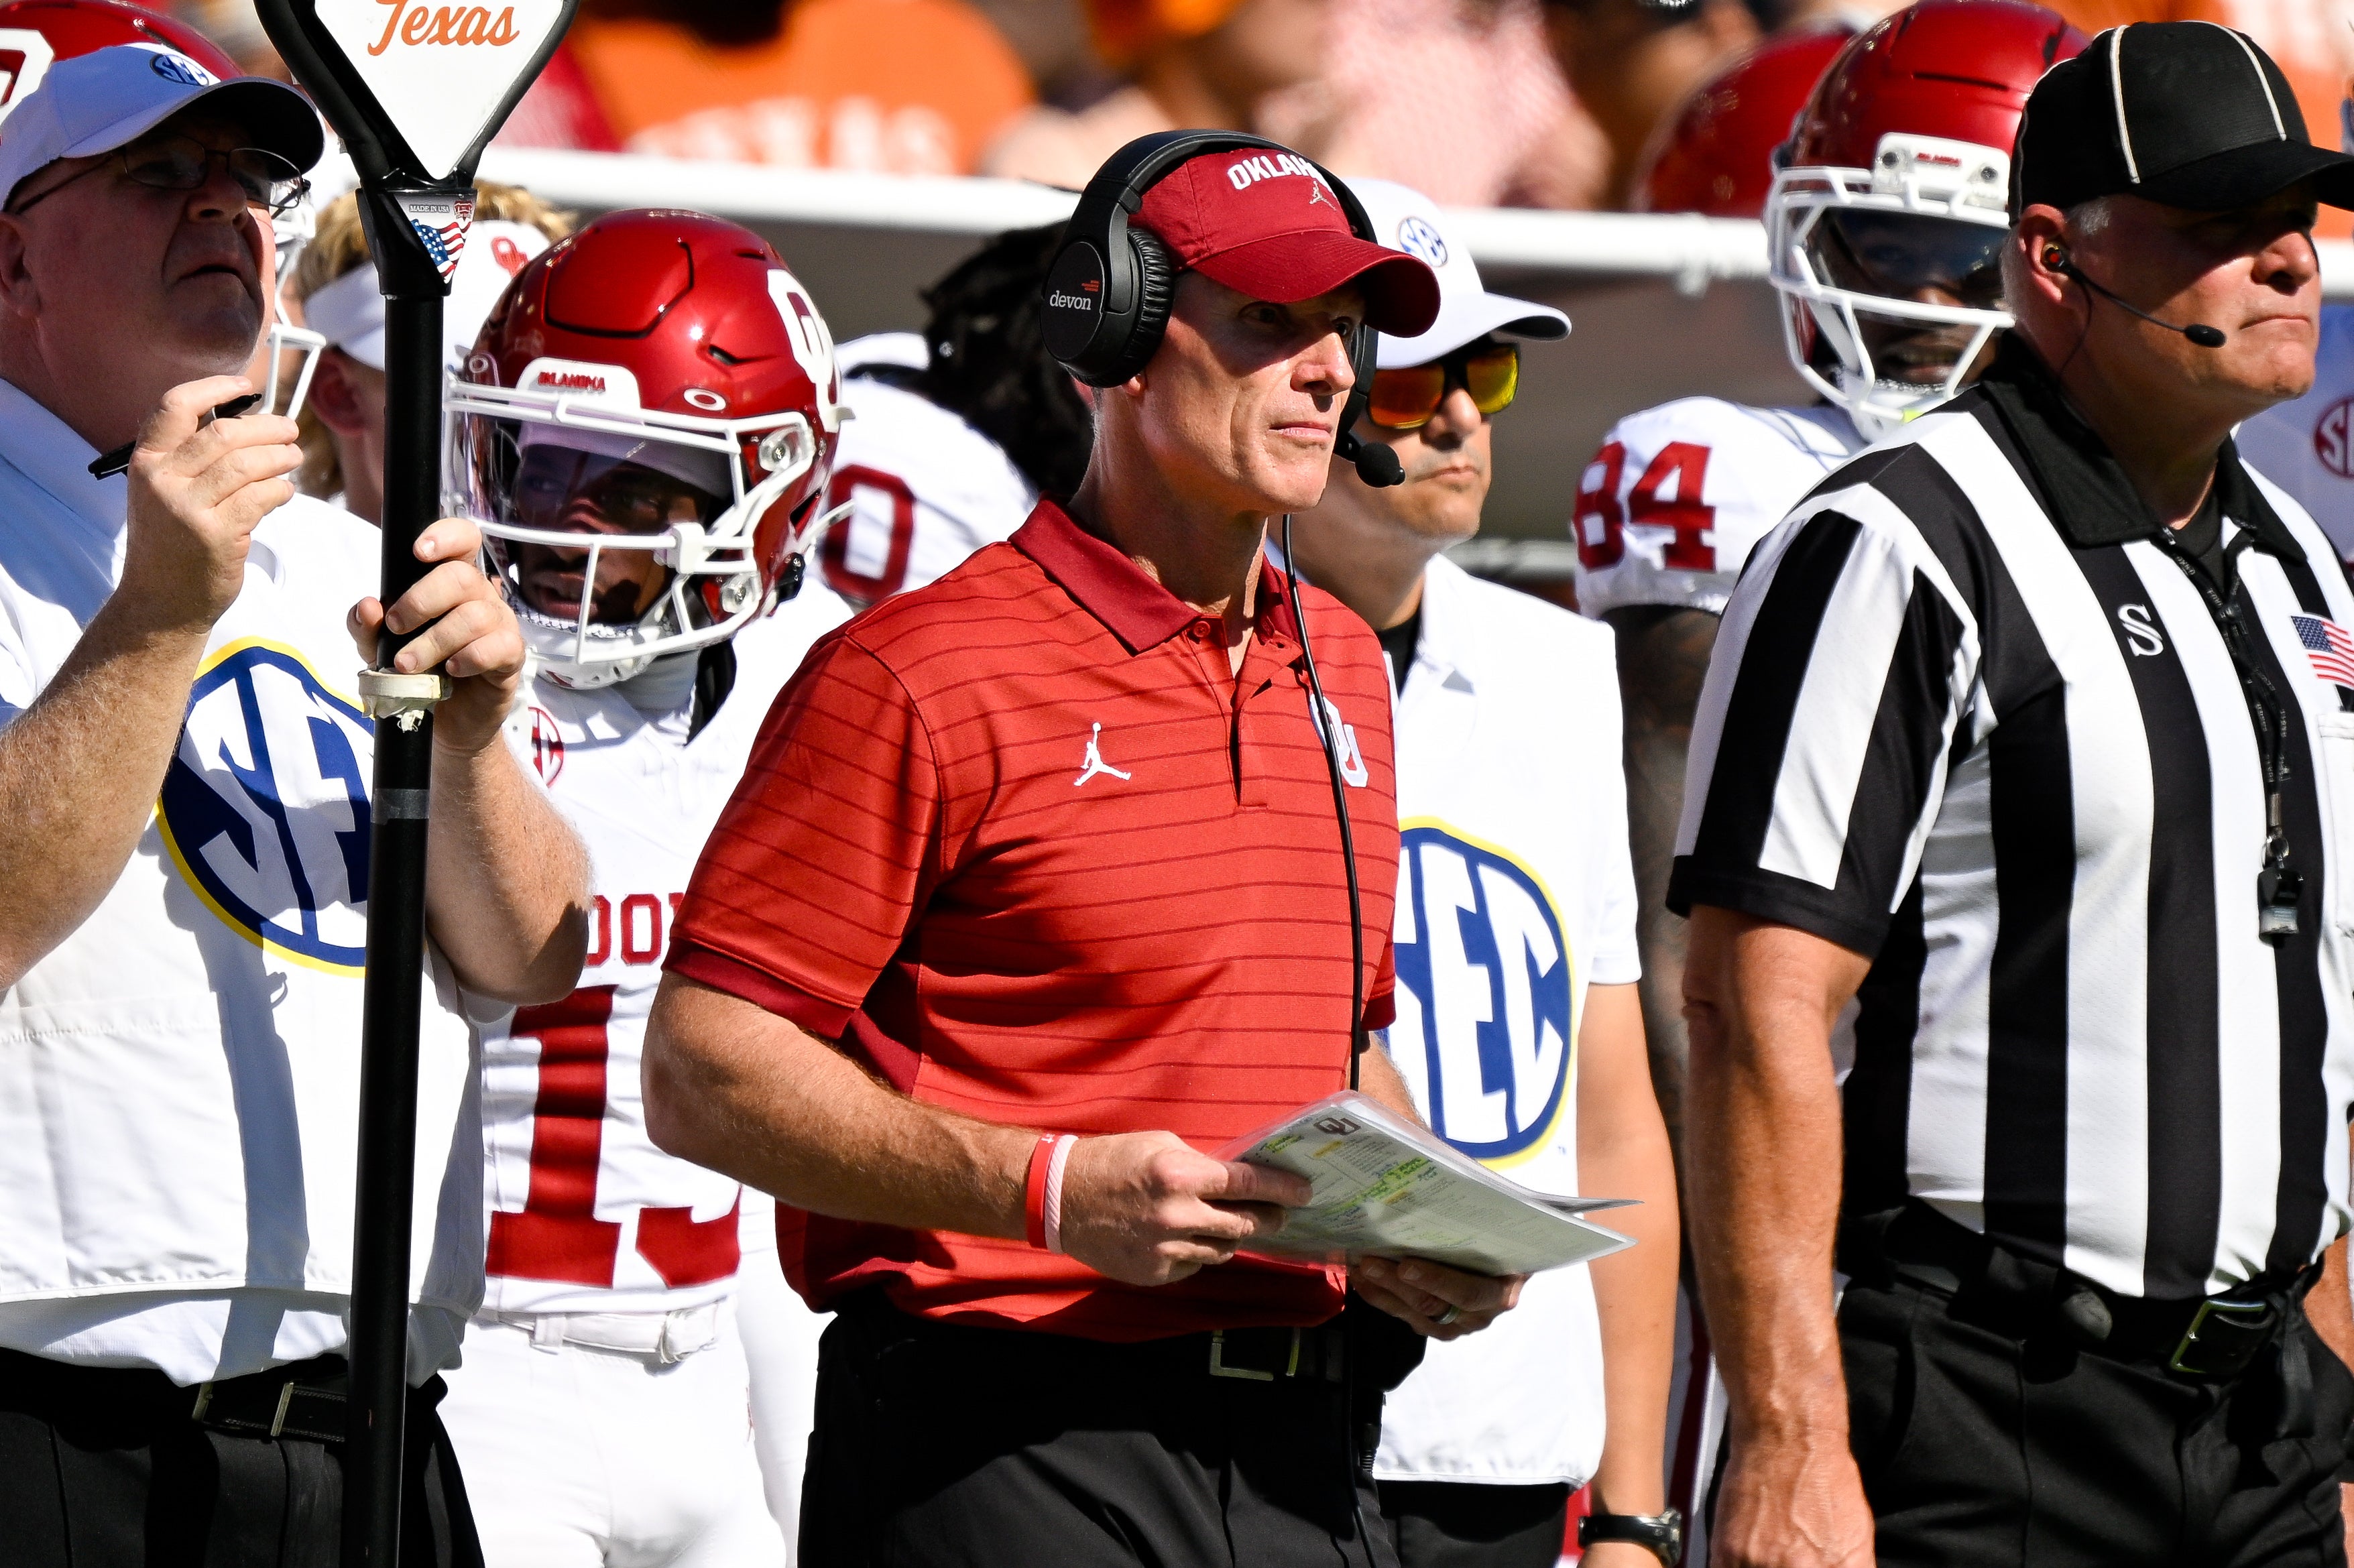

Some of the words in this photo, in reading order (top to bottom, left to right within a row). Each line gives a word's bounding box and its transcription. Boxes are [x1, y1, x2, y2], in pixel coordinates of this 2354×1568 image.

[367, 0, 520, 56] Texas
[152, 54, 209, 86] SEC
[1228, 154, 1332, 194] OKLAH
[1398, 217, 1448, 267] SEC
[1049, 290, 1092, 310] devon
[1572, 440, 1718, 574] 84
[2117, 603, 2164, 657] S
[176, 660, 375, 947] SE
